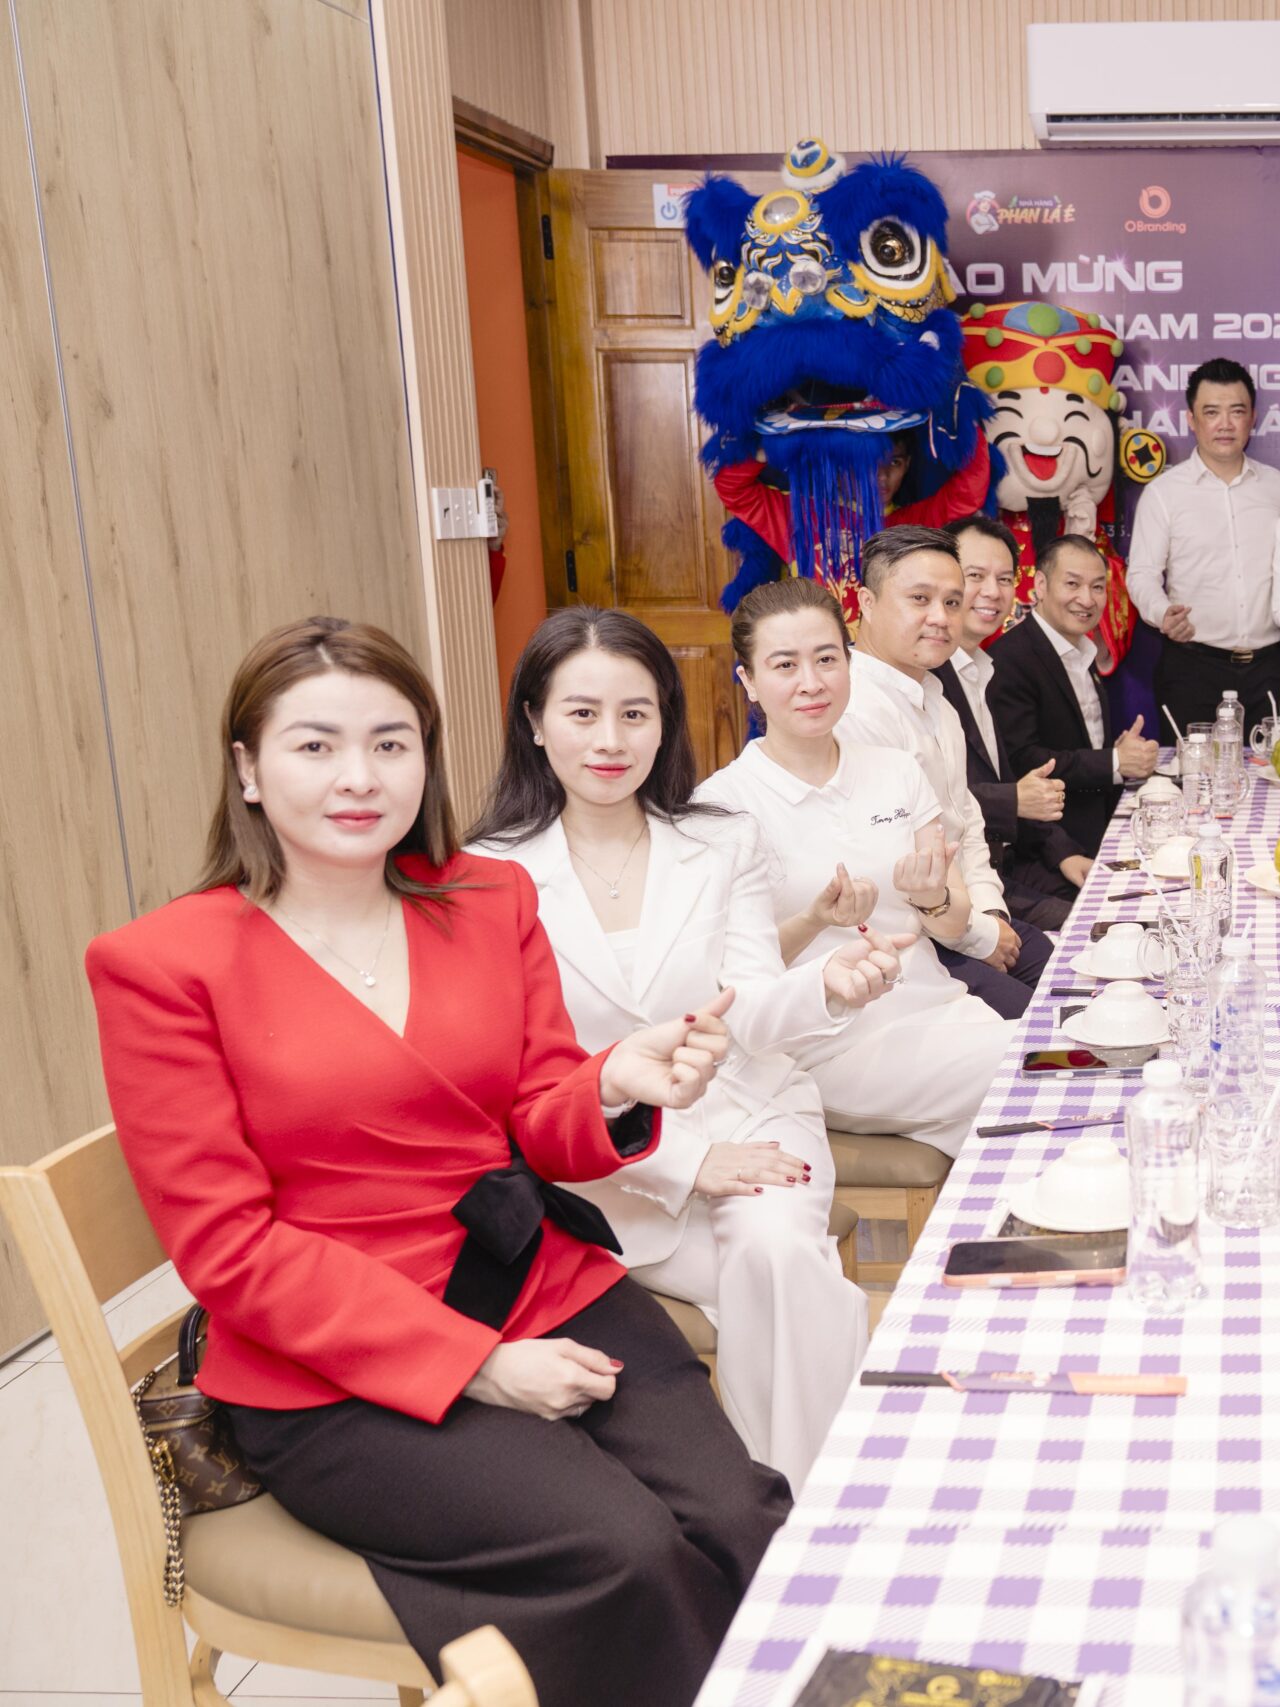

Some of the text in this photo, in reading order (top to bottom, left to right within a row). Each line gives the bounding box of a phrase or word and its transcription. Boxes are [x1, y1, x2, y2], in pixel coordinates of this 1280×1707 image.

[998, 204, 1076, 225] PHAN LÁ É
[1021, 254, 1184, 294] MỪNG
[1099, 312, 1199, 340] NAM
